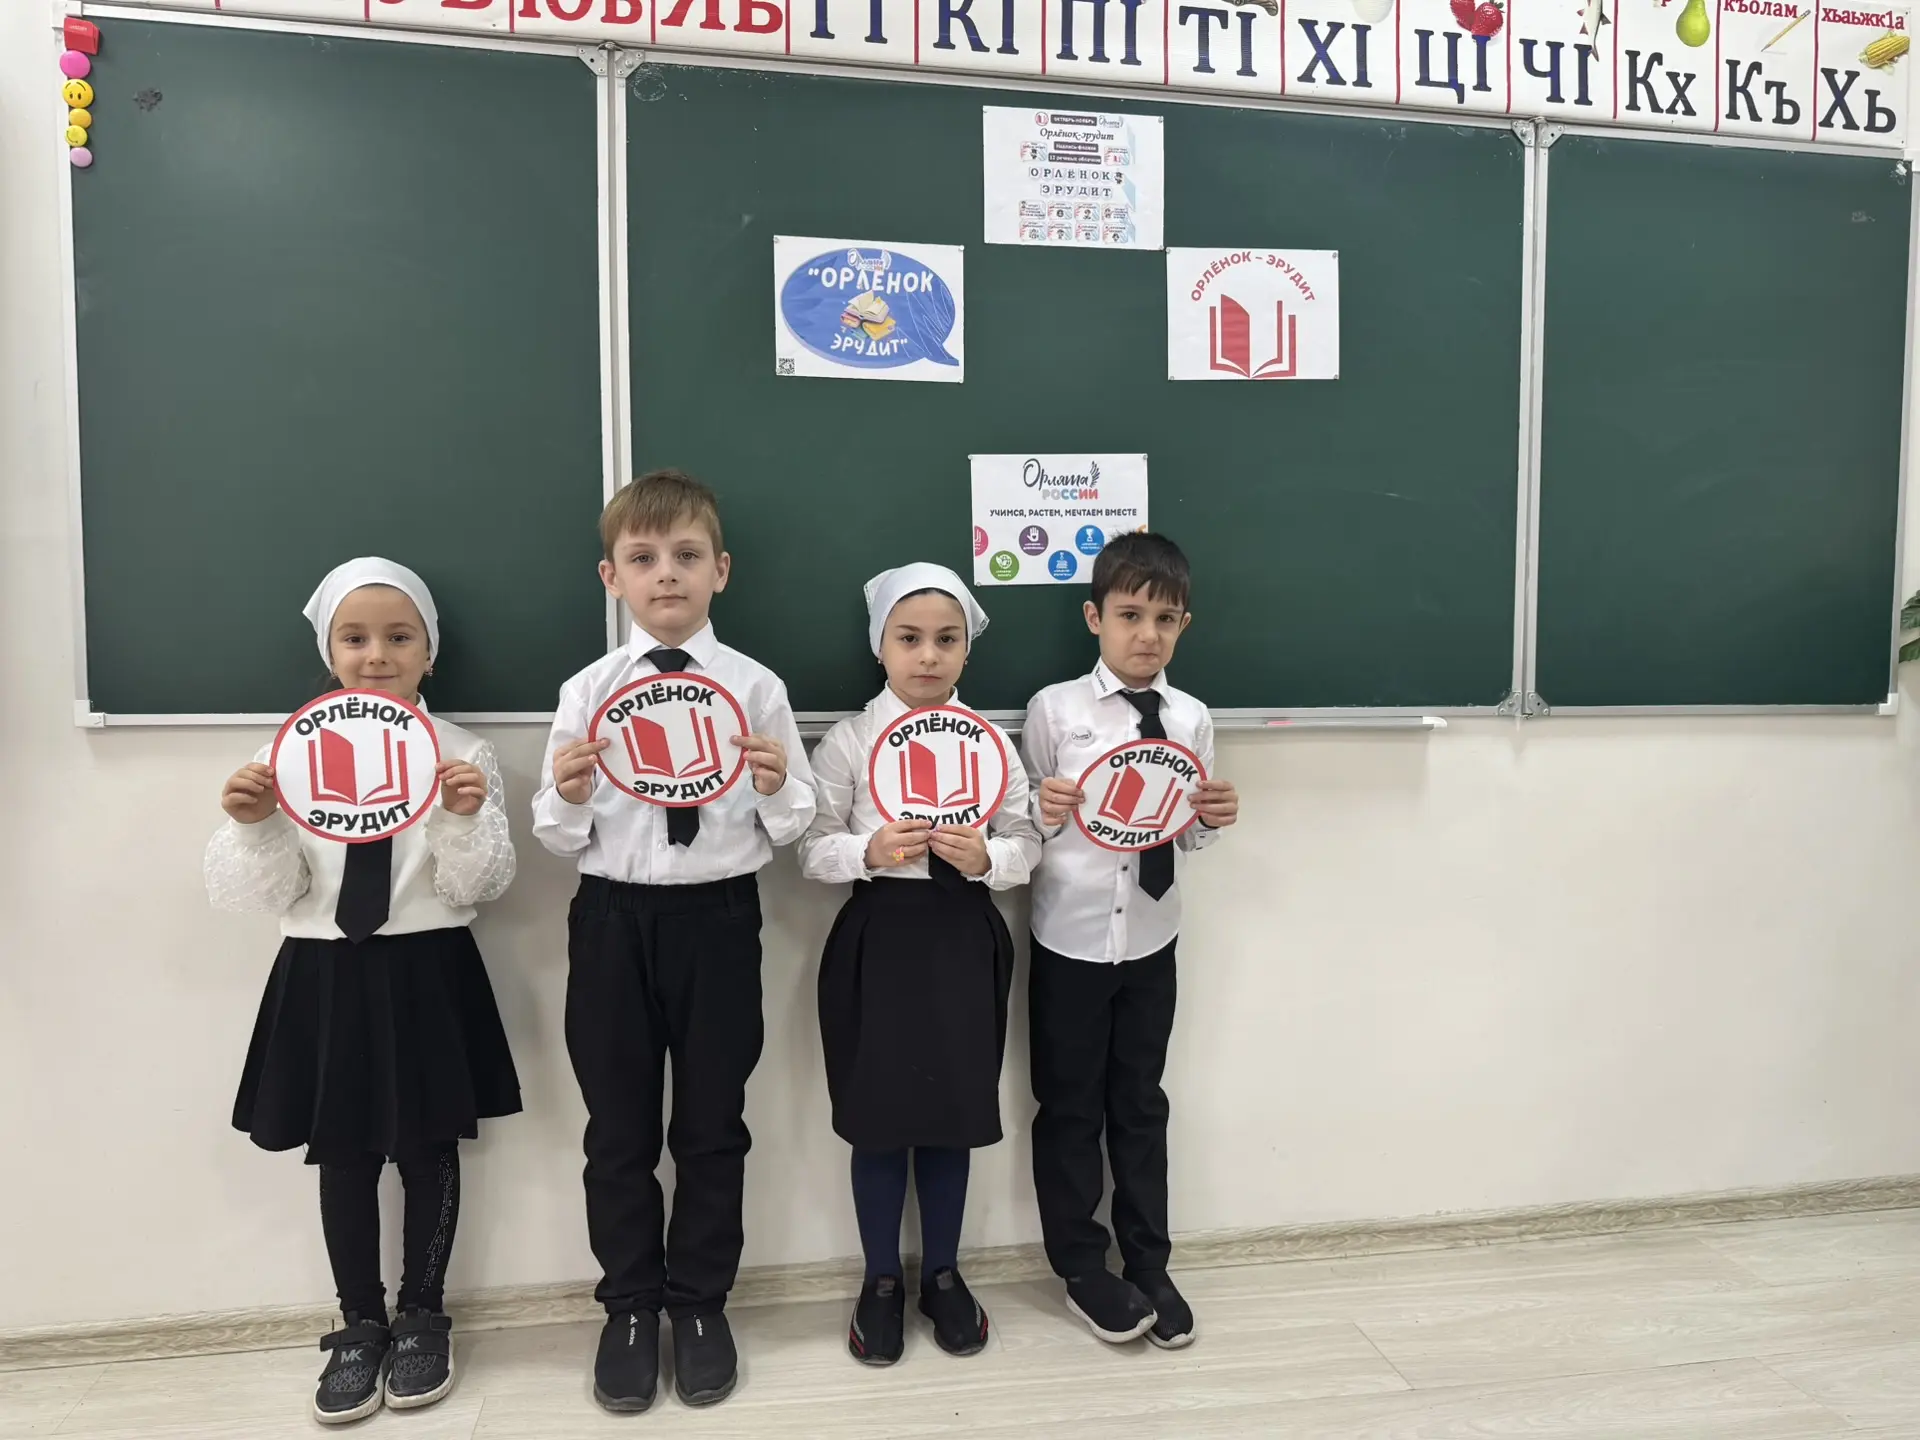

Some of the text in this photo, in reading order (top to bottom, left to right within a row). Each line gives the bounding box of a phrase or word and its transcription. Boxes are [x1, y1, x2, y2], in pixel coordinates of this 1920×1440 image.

[1624, 50, 1697, 117] Кх
[1724, 59, 1801, 126] Къ
[1818, 67, 1897, 134] Хь
[1191, 251, 1252, 302] ОРЛЁНОК
[1266, 254, 1316, 302] ЭРУДИТ
[1022, 458, 1089, 491] Орлята
[1041, 488, 1099, 501] РОССИИ
[989, 508, 1027, 518] УЧИМСЯ,
[1065, 508, 1103, 517] МЕЧТАЕМ
[1105, 508, 1137, 517] ВМЕСТЕ
[295, 696, 415, 736] ОРЛЁНОК
[606, 682, 716, 724] ОРЛЁНОК
[888, 712, 985, 748] ОРЛЁНОК
[1109, 746, 1198, 783] ОРЛЁНОК
[633, 769, 725, 800] ЭРУДИТ
[308, 801, 411, 834] ЭРУДИТ
[1086, 820, 1163, 846] ЭРУДИТ
[340, 1349, 364, 1364] MK
[397, 1335, 419, 1352] MK
